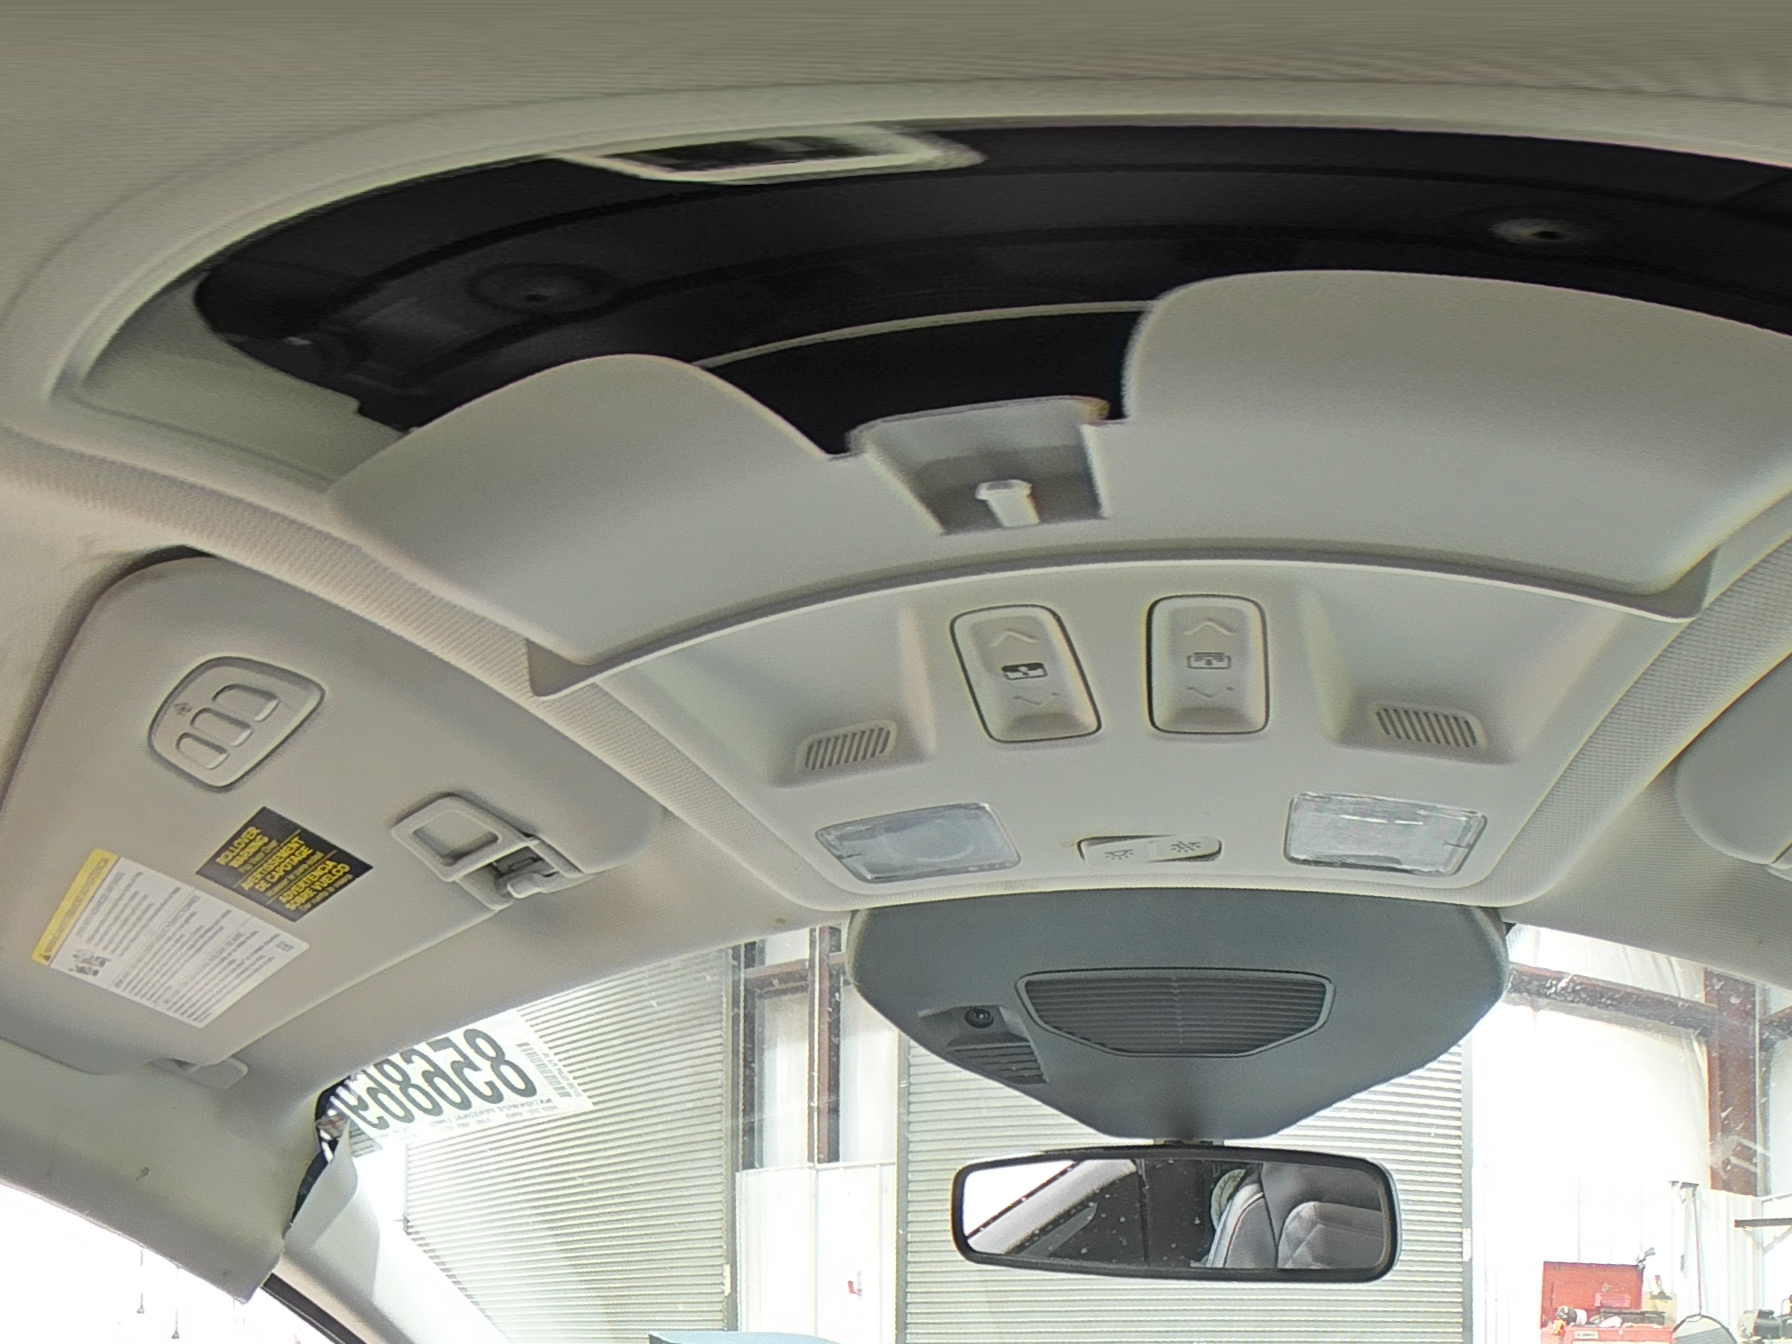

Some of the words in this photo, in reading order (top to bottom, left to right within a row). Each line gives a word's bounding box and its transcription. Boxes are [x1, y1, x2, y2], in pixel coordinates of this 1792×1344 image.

[215, 826, 261, 866] ROLLOVER
[241, 835, 305, 892] AVERTISSEMENT
[255, 879, 272, 893] DE
[266, 845, 313, 883] CAPOTAGE
[278, 860, 338, 903] ADVERTENCIA
[311, 863, 351, 891] VUELCO
